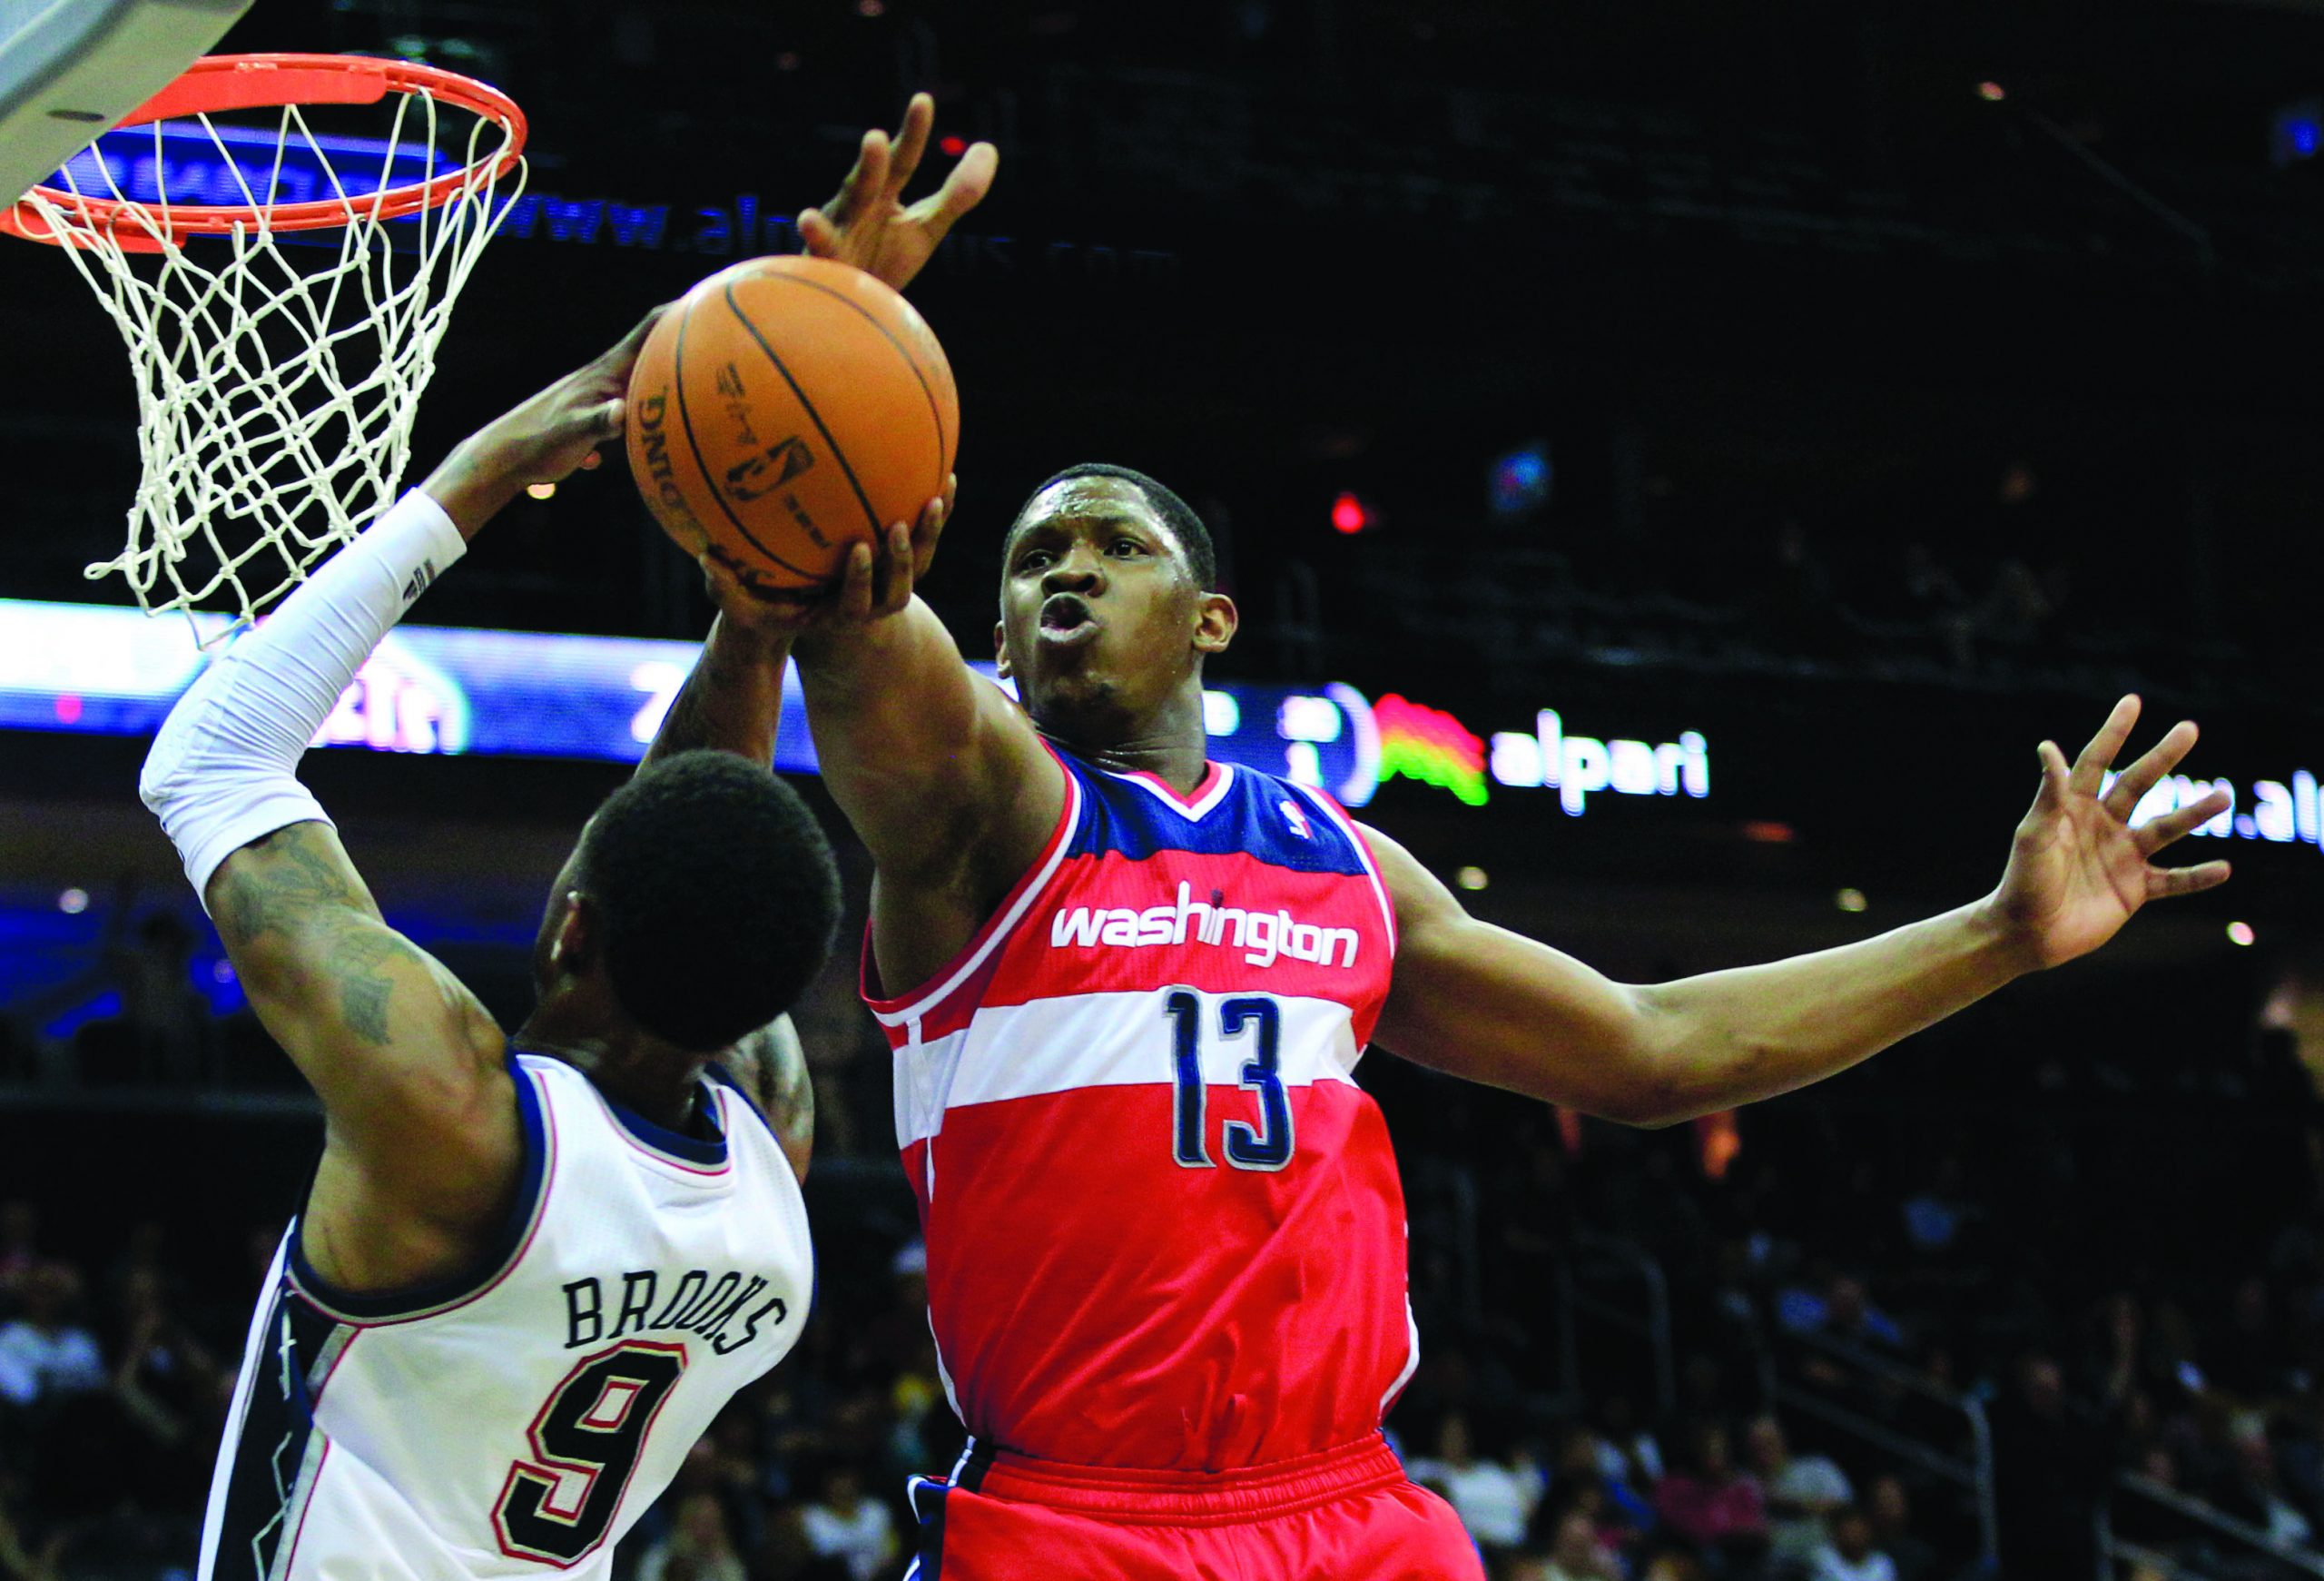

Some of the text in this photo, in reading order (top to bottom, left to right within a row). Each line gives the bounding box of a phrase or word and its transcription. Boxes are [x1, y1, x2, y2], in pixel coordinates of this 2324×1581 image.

[1491, 708, 1709, 815] alpari
[1050, 880, 1360, 968] washington
[1163, 983, 1295, 1171] 13
[561, 1270, 788, 1356] BROOKS
[490, 1339, 688, 1569] 9
